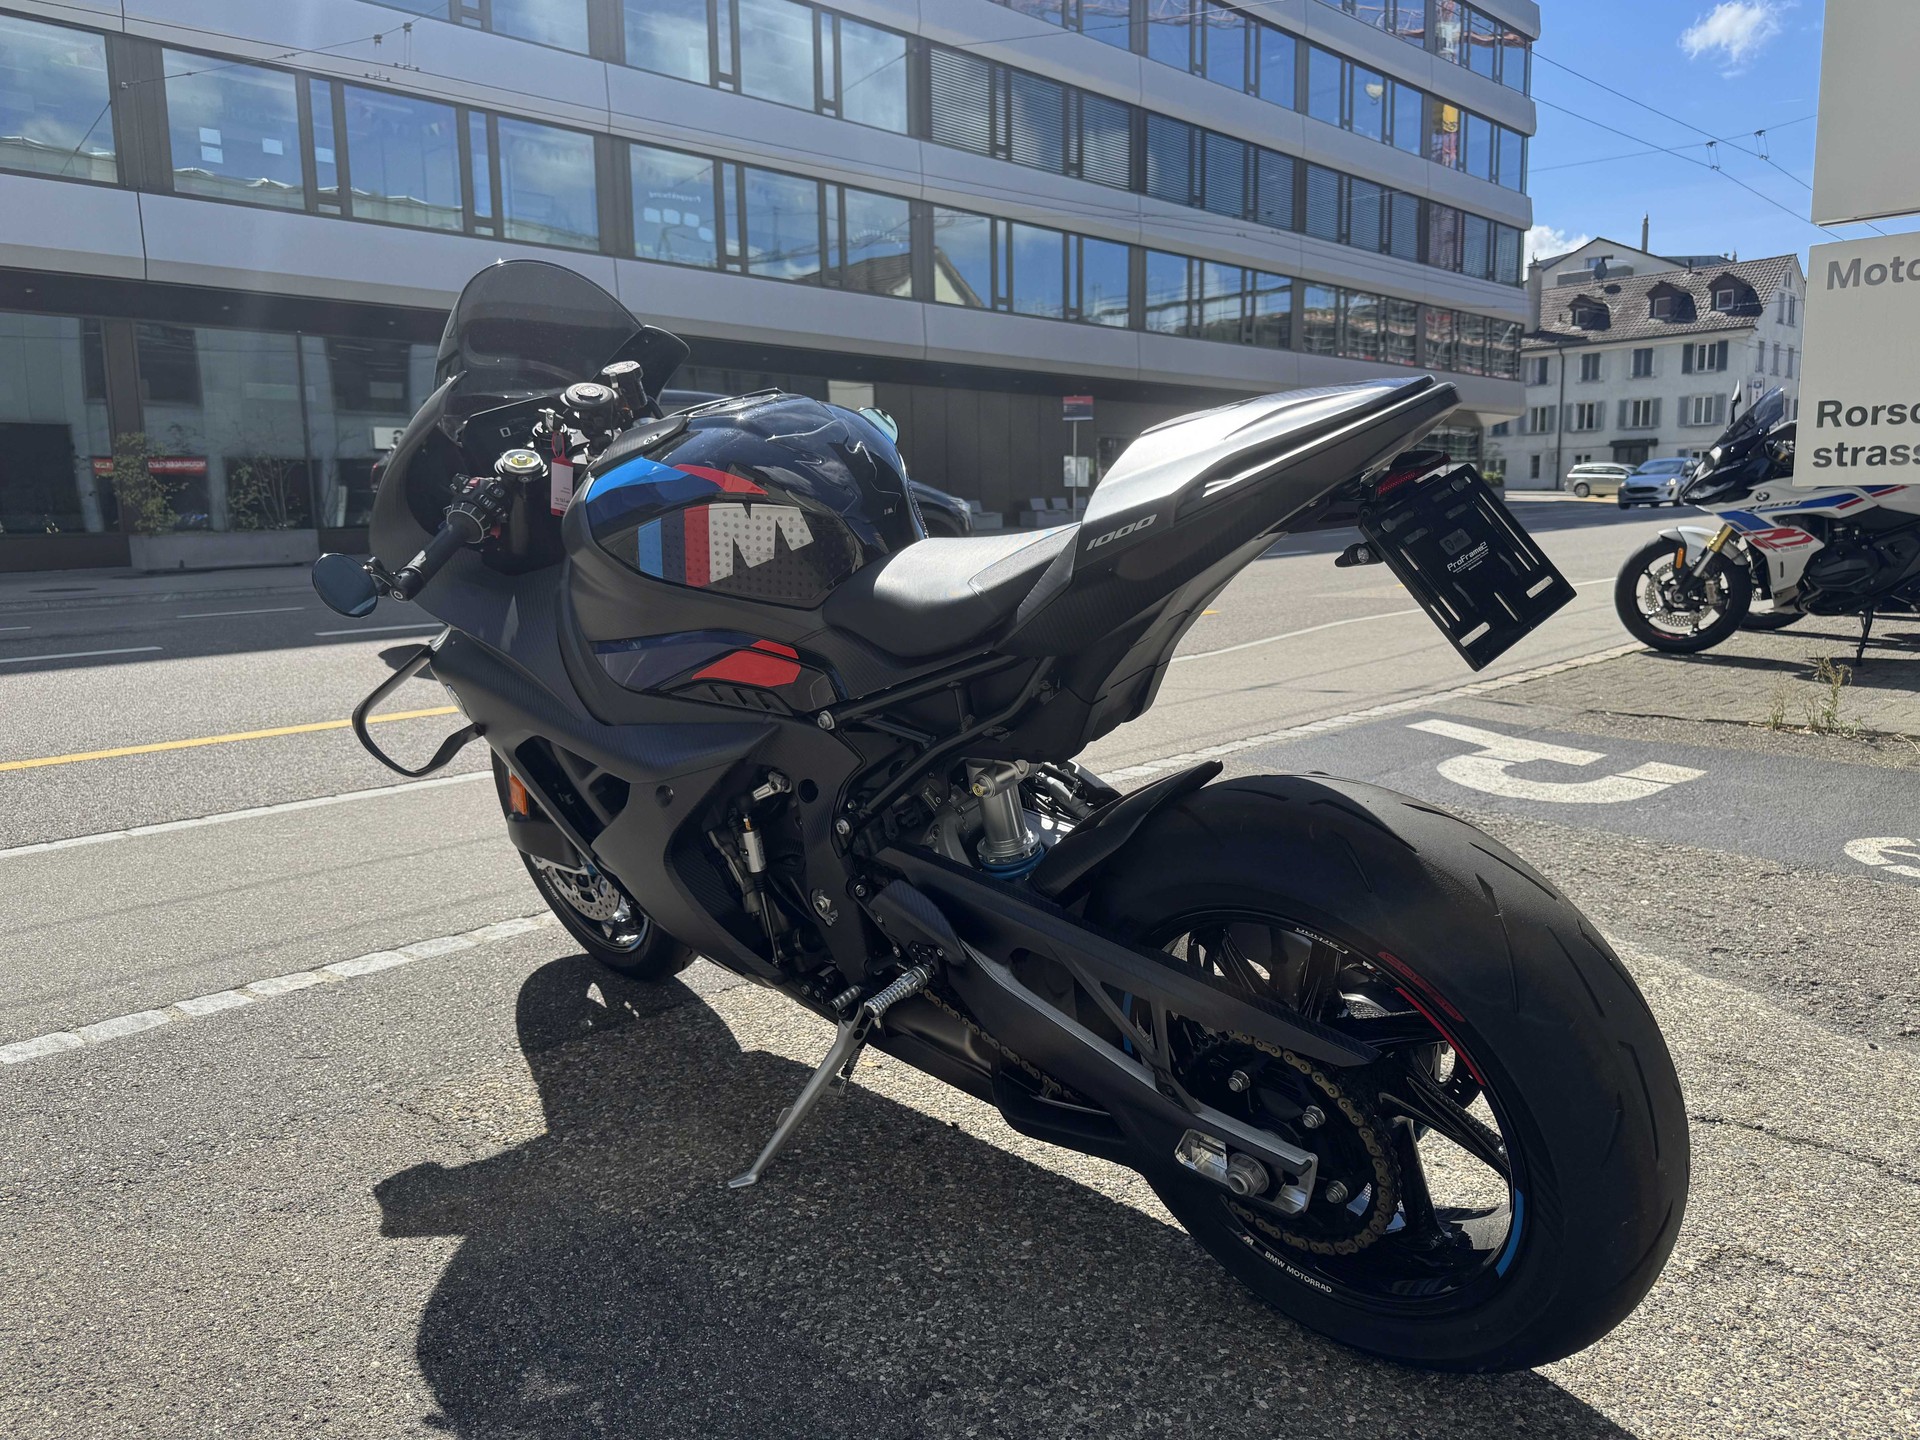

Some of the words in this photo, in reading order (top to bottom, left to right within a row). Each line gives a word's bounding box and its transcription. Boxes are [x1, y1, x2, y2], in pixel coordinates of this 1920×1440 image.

[1086, 514, 1157, 551] 1000
[1264, 1250, 1286, 1268] BMW
[1286, 1265, 1333, 1293] MOTORRAD
